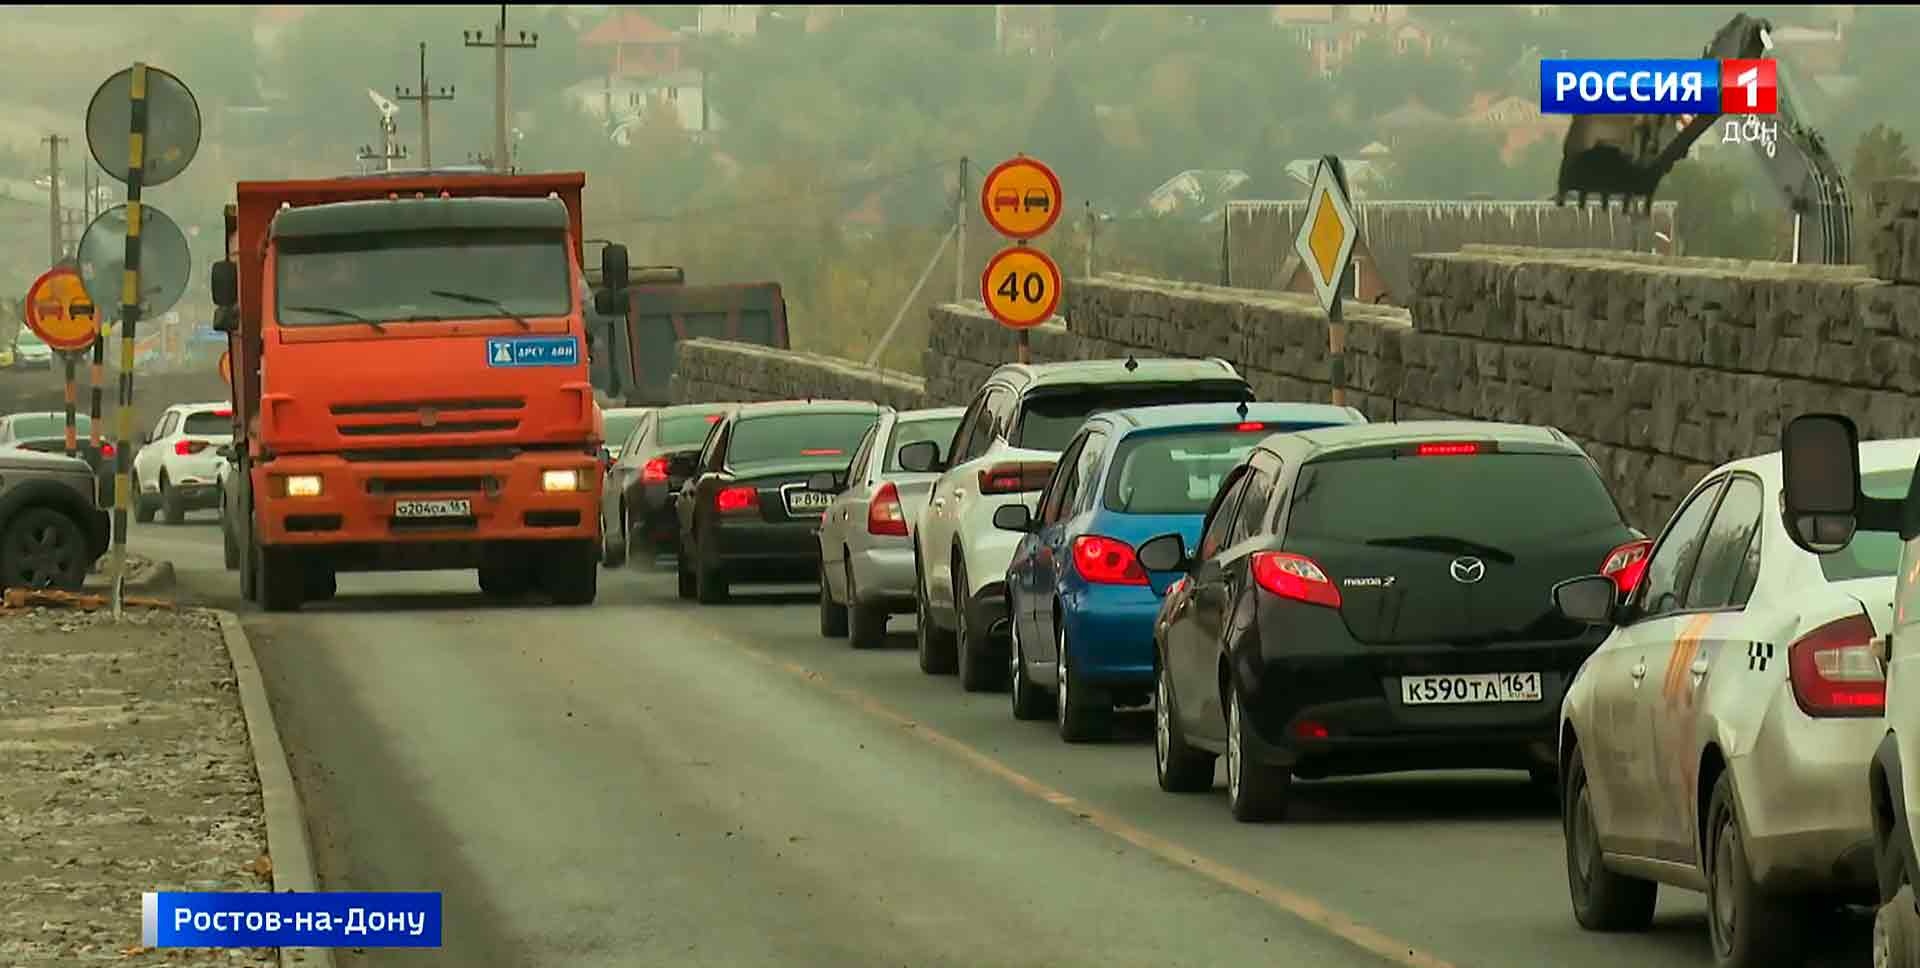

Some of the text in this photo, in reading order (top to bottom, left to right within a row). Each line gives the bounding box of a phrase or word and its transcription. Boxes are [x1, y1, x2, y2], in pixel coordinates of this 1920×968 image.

[997, 271, 1044, 304] 40
[1409, 675, 1535, 701] К590ТА 161
